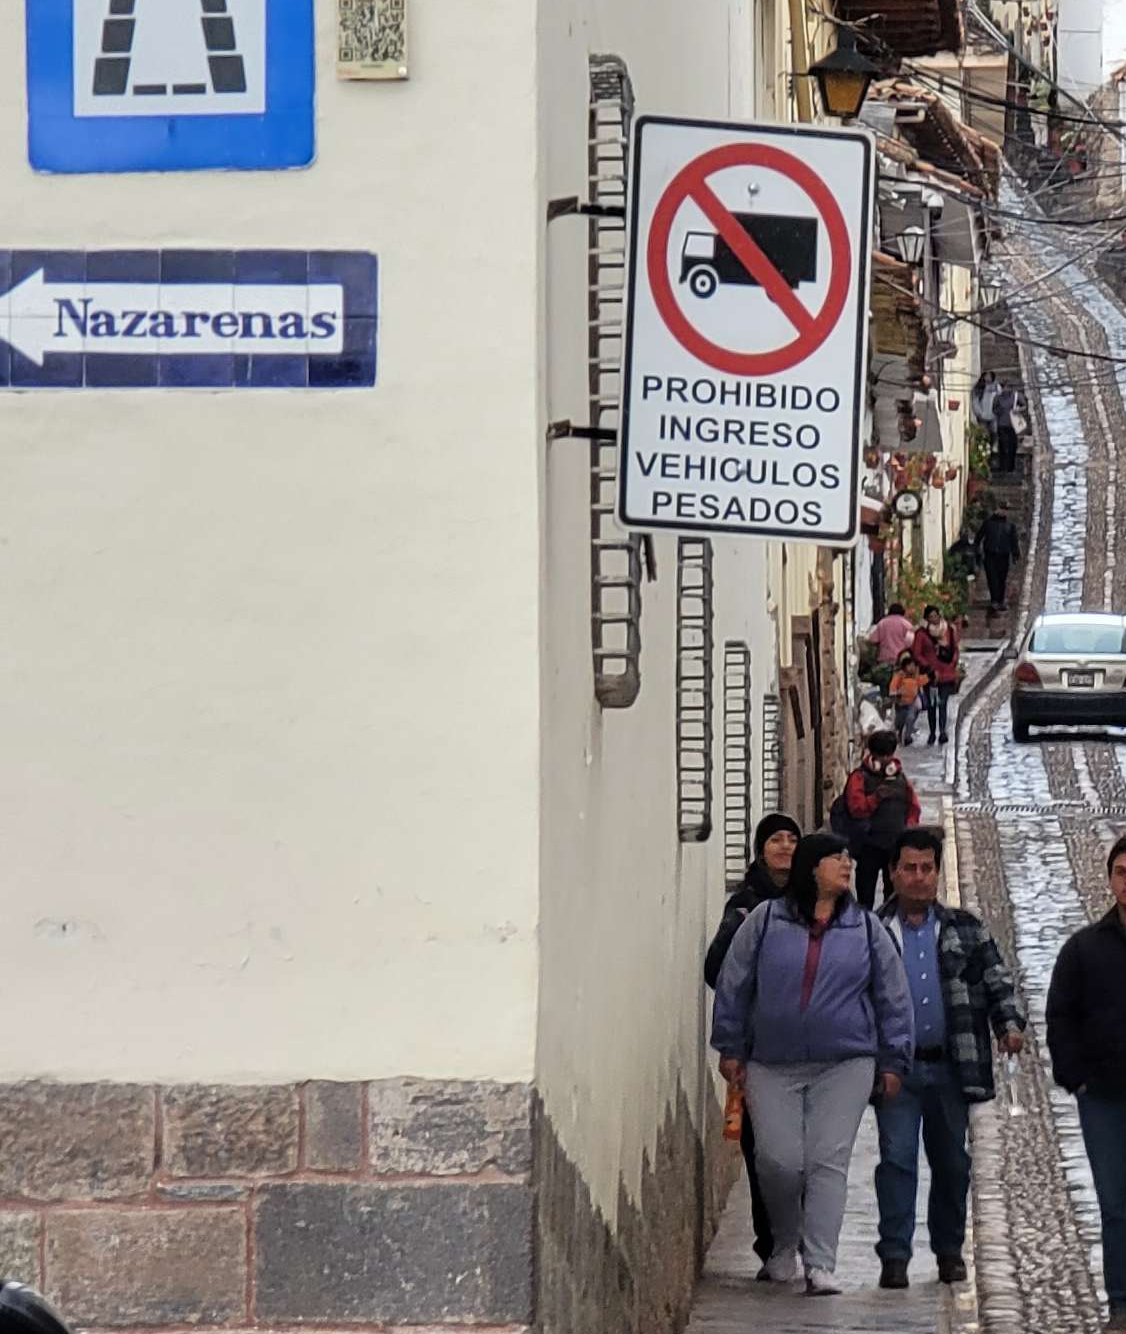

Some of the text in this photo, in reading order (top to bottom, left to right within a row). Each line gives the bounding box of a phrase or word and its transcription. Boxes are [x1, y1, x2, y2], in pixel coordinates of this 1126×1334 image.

[54, 298, 337, 339] Nazarenas
[642, 375, 840, 412] PROHIBIDO
[659, 415, 820, 449] INGRESO
[636, 452, 840, 489] VEHICULOS
[651, 491, 822, 526] PESADOS
